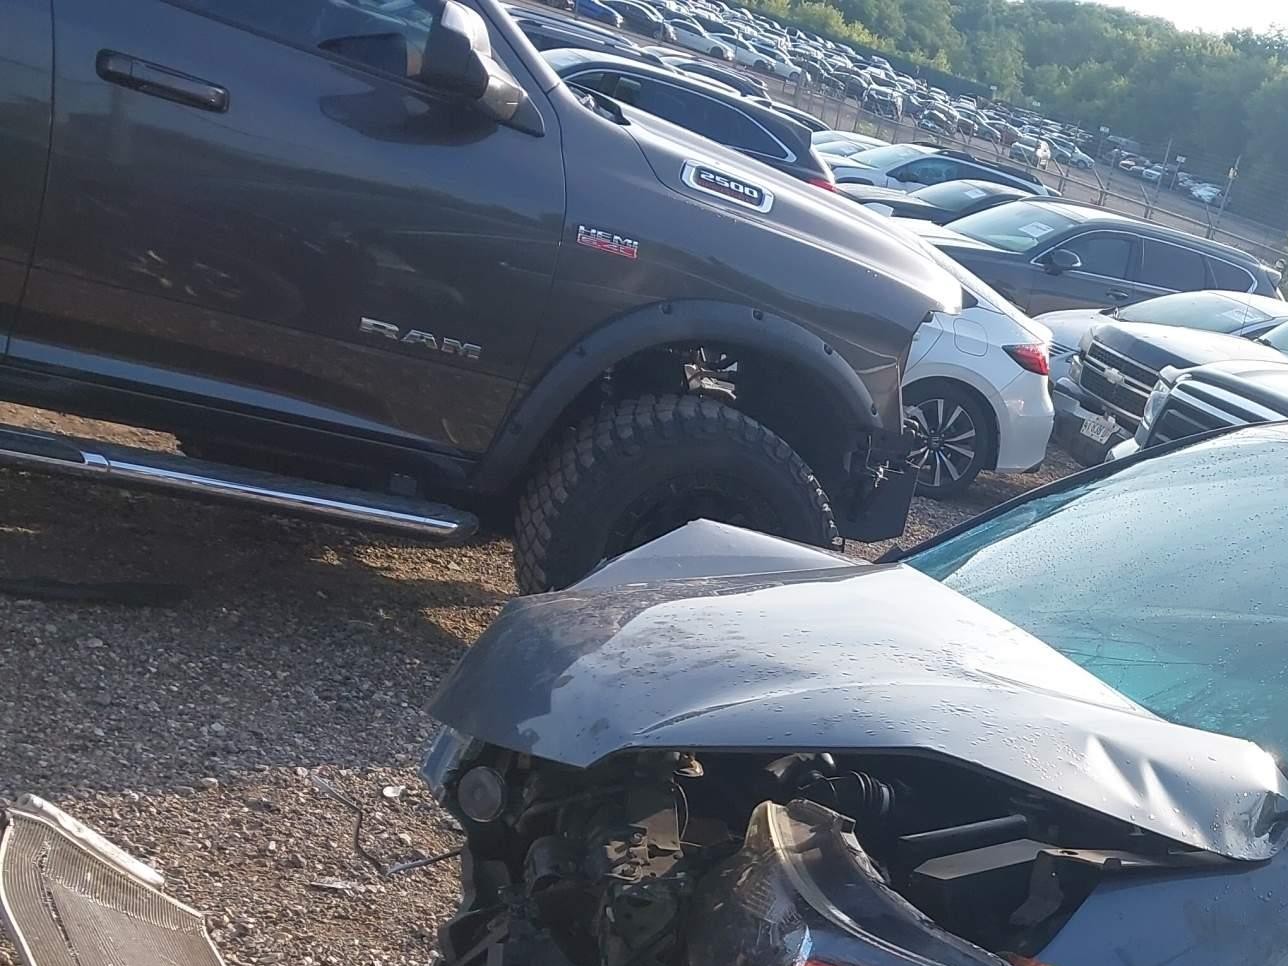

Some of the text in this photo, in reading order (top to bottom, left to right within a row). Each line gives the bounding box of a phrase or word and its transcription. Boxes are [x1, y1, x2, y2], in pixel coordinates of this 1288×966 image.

[700, 170, 759, 199] 2500
[578, 225, 640, 249] HEMI
[360, 316, 482, 360] RAM
